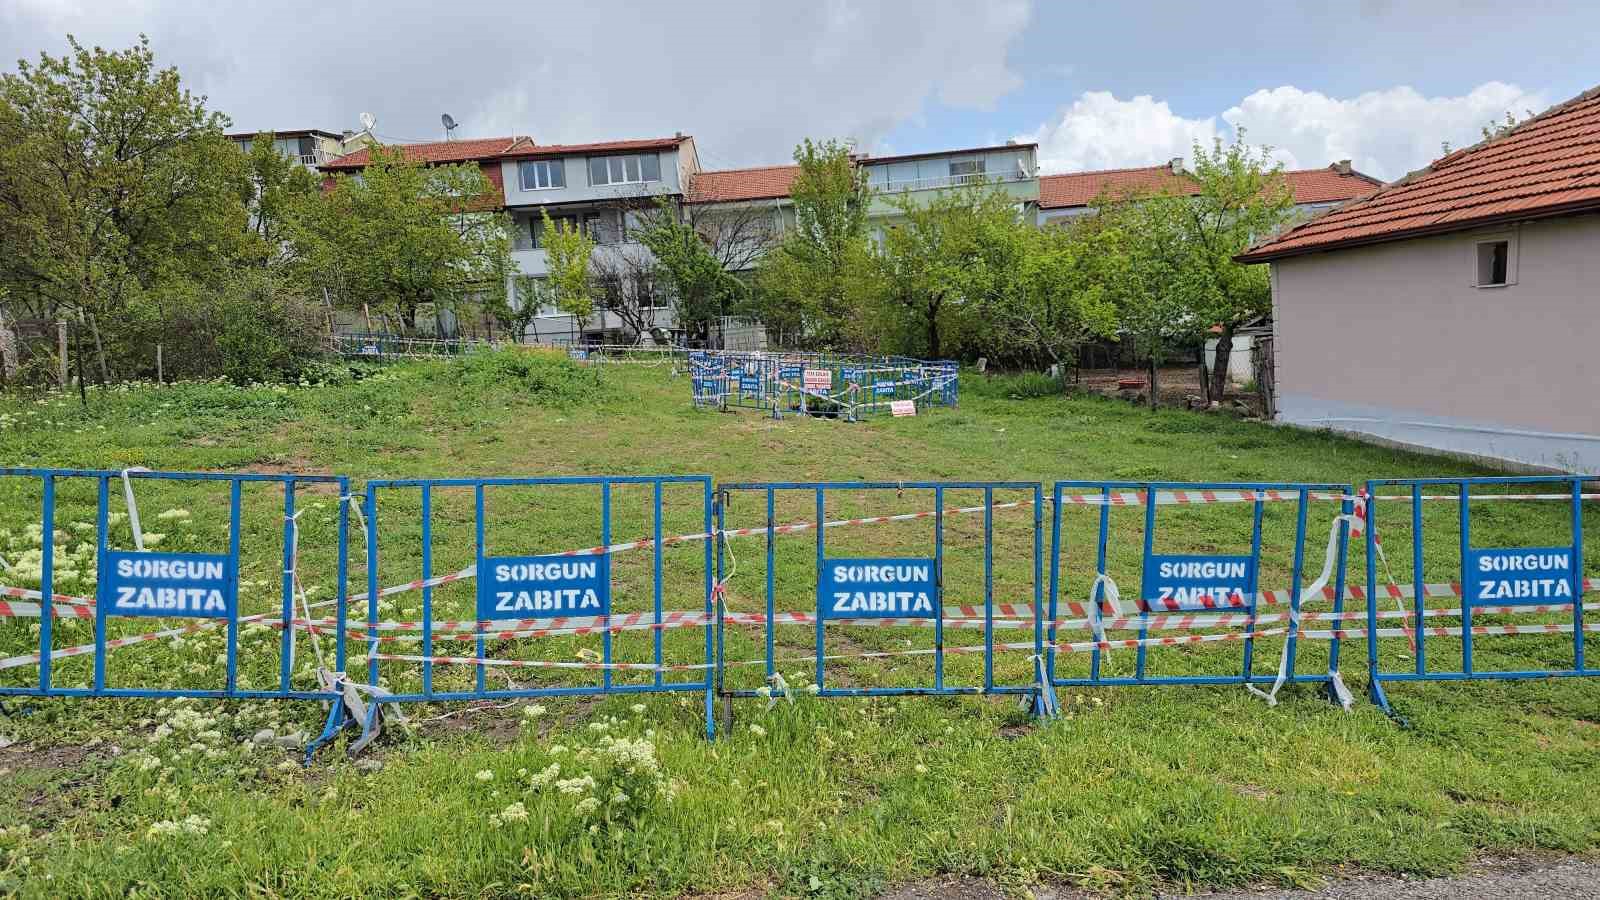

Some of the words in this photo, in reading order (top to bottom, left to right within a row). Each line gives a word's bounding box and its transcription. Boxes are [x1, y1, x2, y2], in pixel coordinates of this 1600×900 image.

[117, 559, 223, 579] SORGUN
[495, 562, 596, 582] SORGUN
[1159, 562, 1246, 578] SORGUN
[1479, 554, 1569, 572] SORGUN
[833, 565, 929, 583] SORGUN
[1478, 578, 1572, 599] ZABITA
[115, 587, 226, 611] ZABITA
[495, 589, 600, 611] ZABITA
[832, 592, 932, 612] ZABITA
